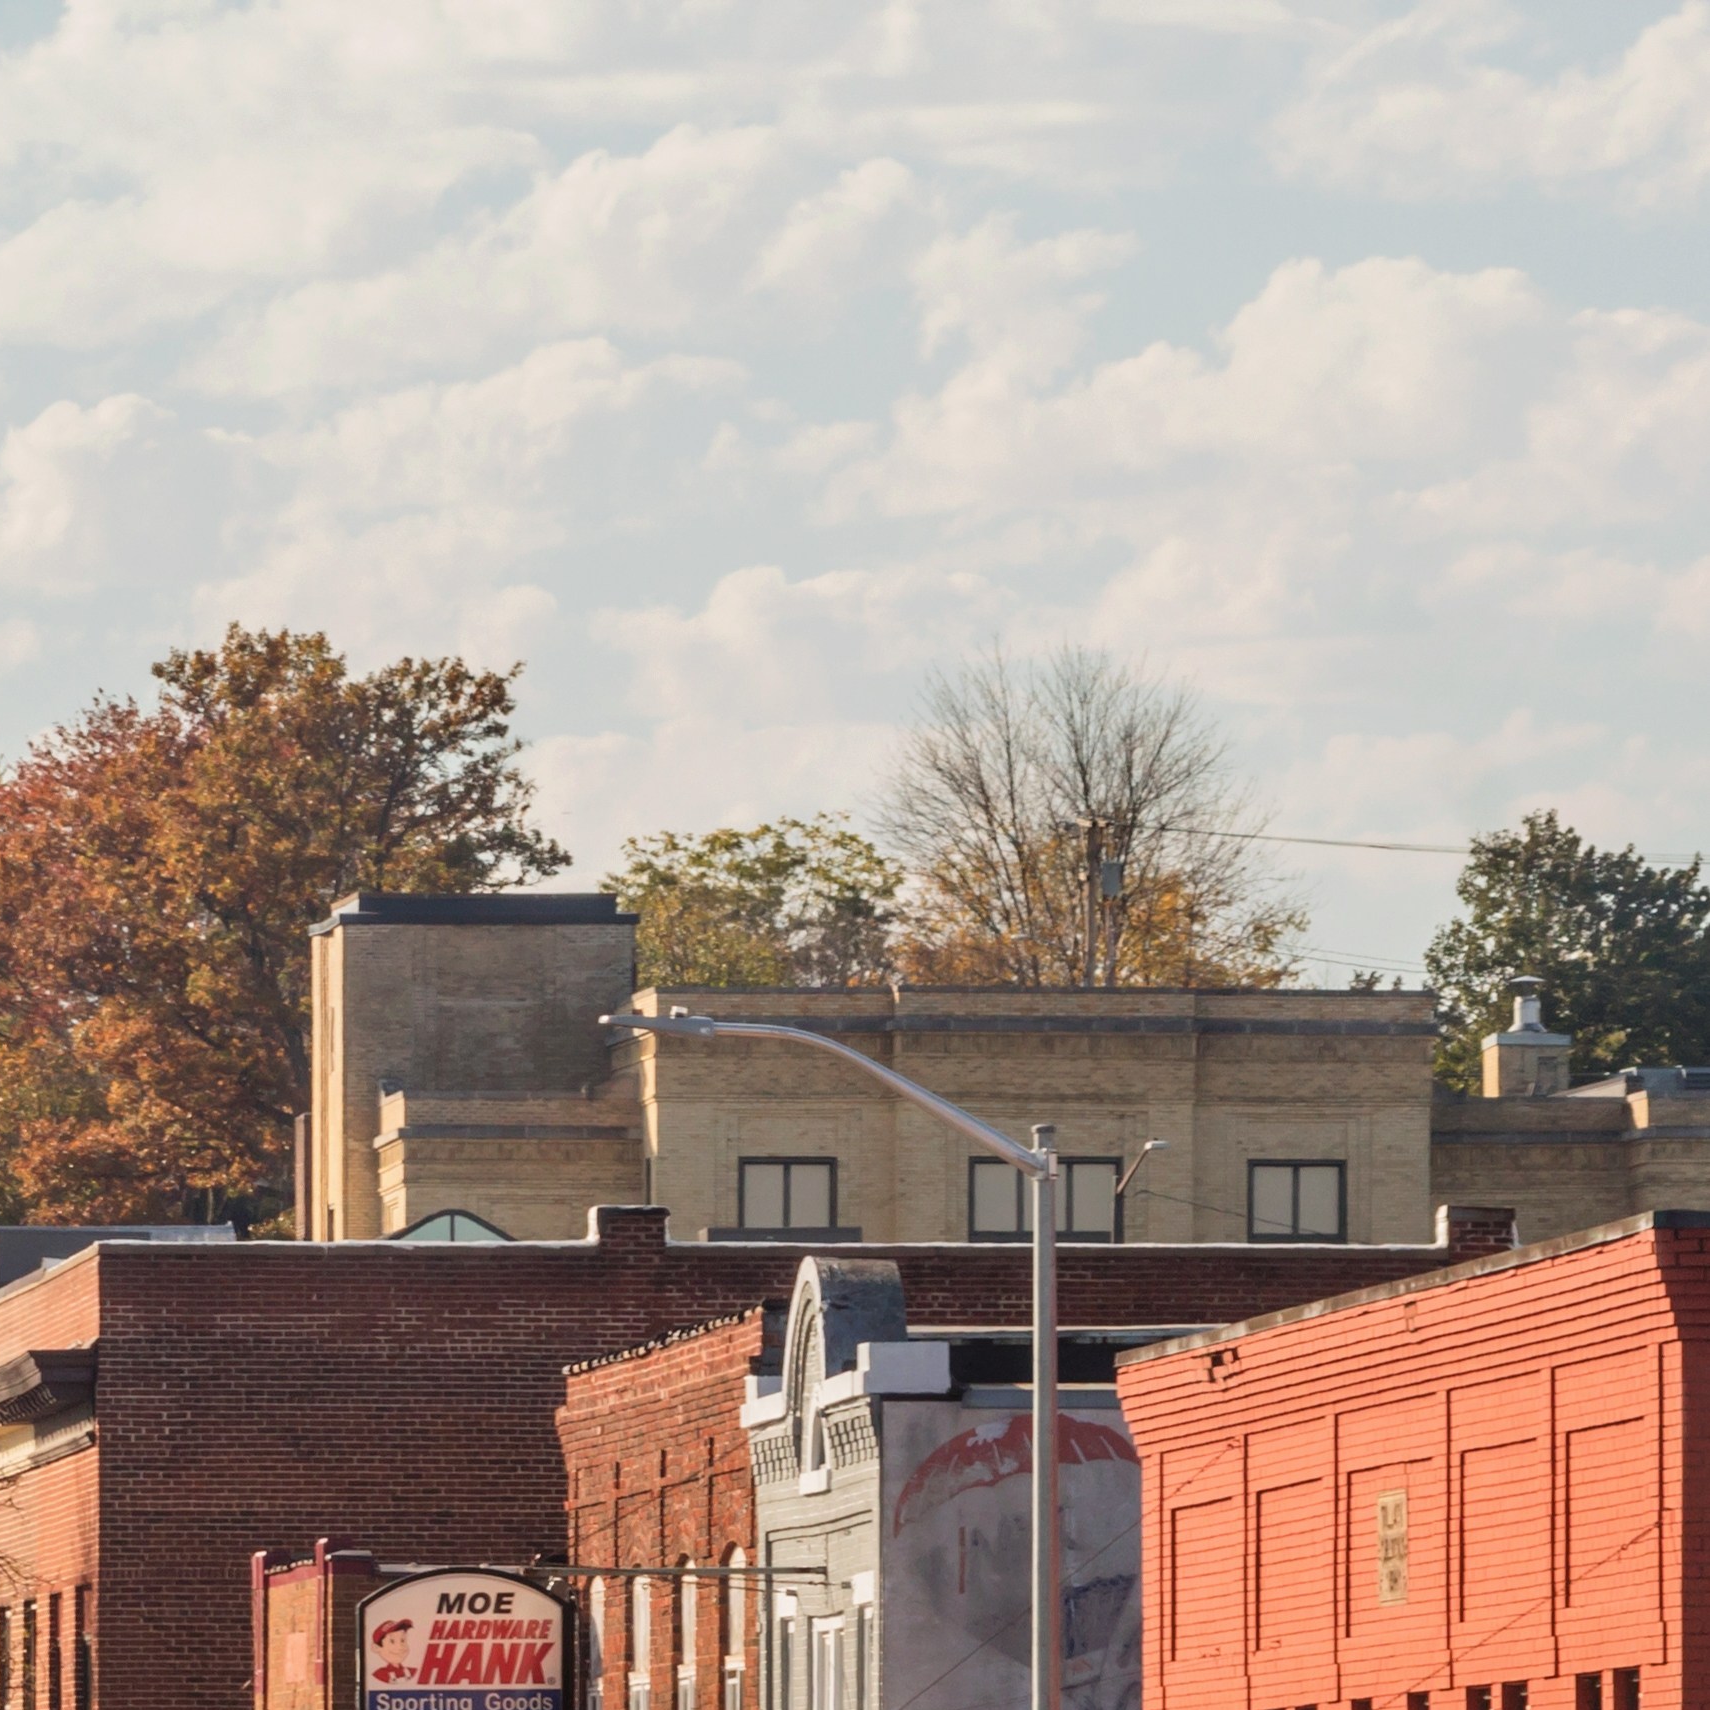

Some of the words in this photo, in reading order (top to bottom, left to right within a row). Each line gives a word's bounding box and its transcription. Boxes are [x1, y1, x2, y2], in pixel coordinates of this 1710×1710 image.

[436, 1591, 516, 1615] MOE
[429, 1619, 553, 1640] HARDWARE
[416, 1642, 556, 1685] HANK
